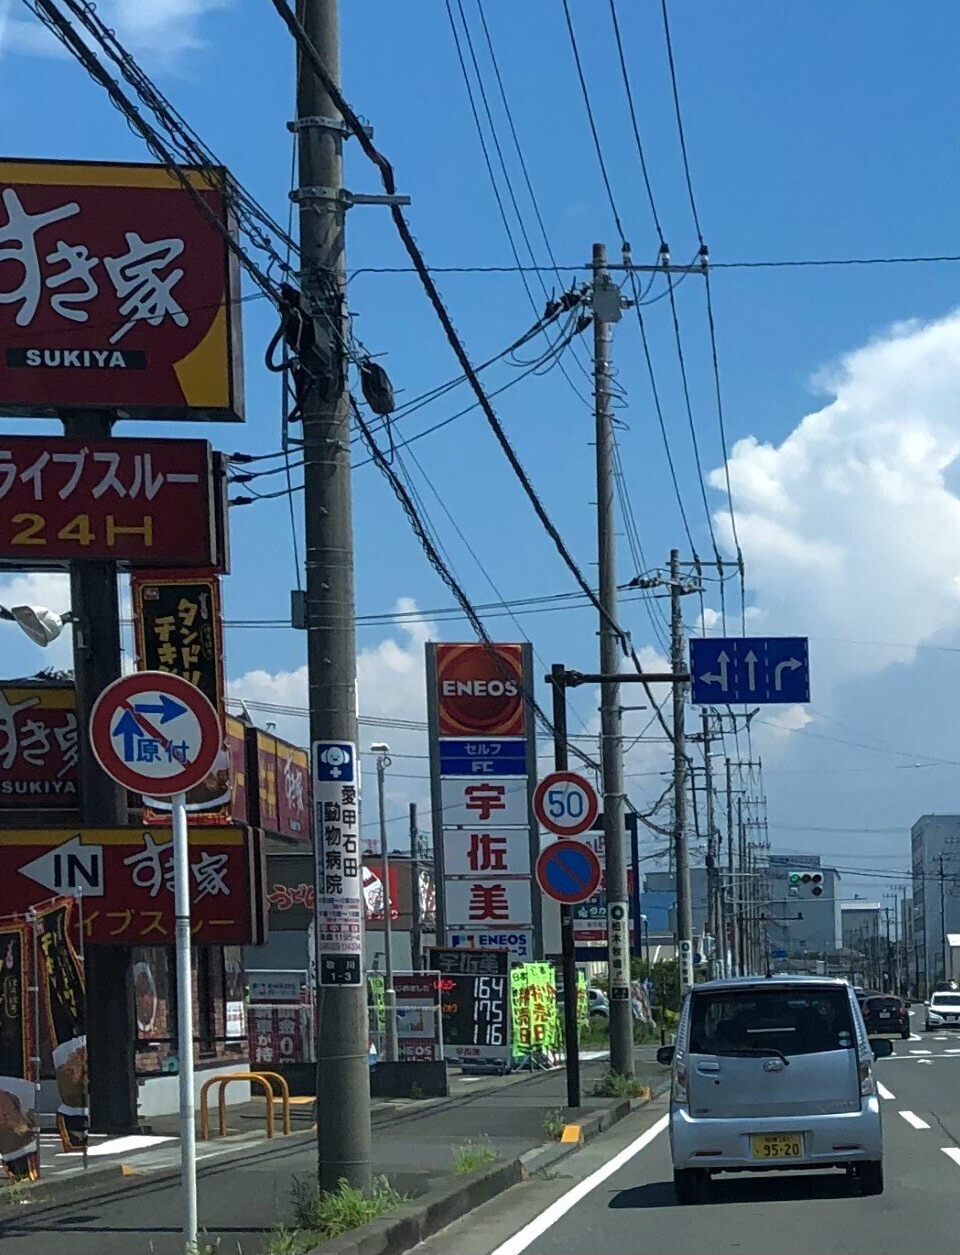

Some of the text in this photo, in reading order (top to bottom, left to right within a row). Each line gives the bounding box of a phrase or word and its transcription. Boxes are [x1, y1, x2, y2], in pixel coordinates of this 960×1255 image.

[26, 349, 126, 368] SUKIYA
[10, 513, 154, 546] 24H
[442, 680, 519, 697] ENEOS
[136, 738, 190, 763] 原付
[464, 743, 502, 755] セルフ
[2, 781, 77, 794] SUKIYA
[548, 790, 584, 819] 50
[341, 785, 358, 877] 愛甲石田
[323, 801, 343, 895] 動物病院
[464, 783, 509, 920] 宇佐美
[53, 854, 99, 888] IN
[480, 935, 528, 946] ENEOS
[330, 972, 352, 982] 1-3
[474, 977, 504, 999] 164
[473, 1000, 503, 1022] 175
[473, 1024, 503, 1045] 116
